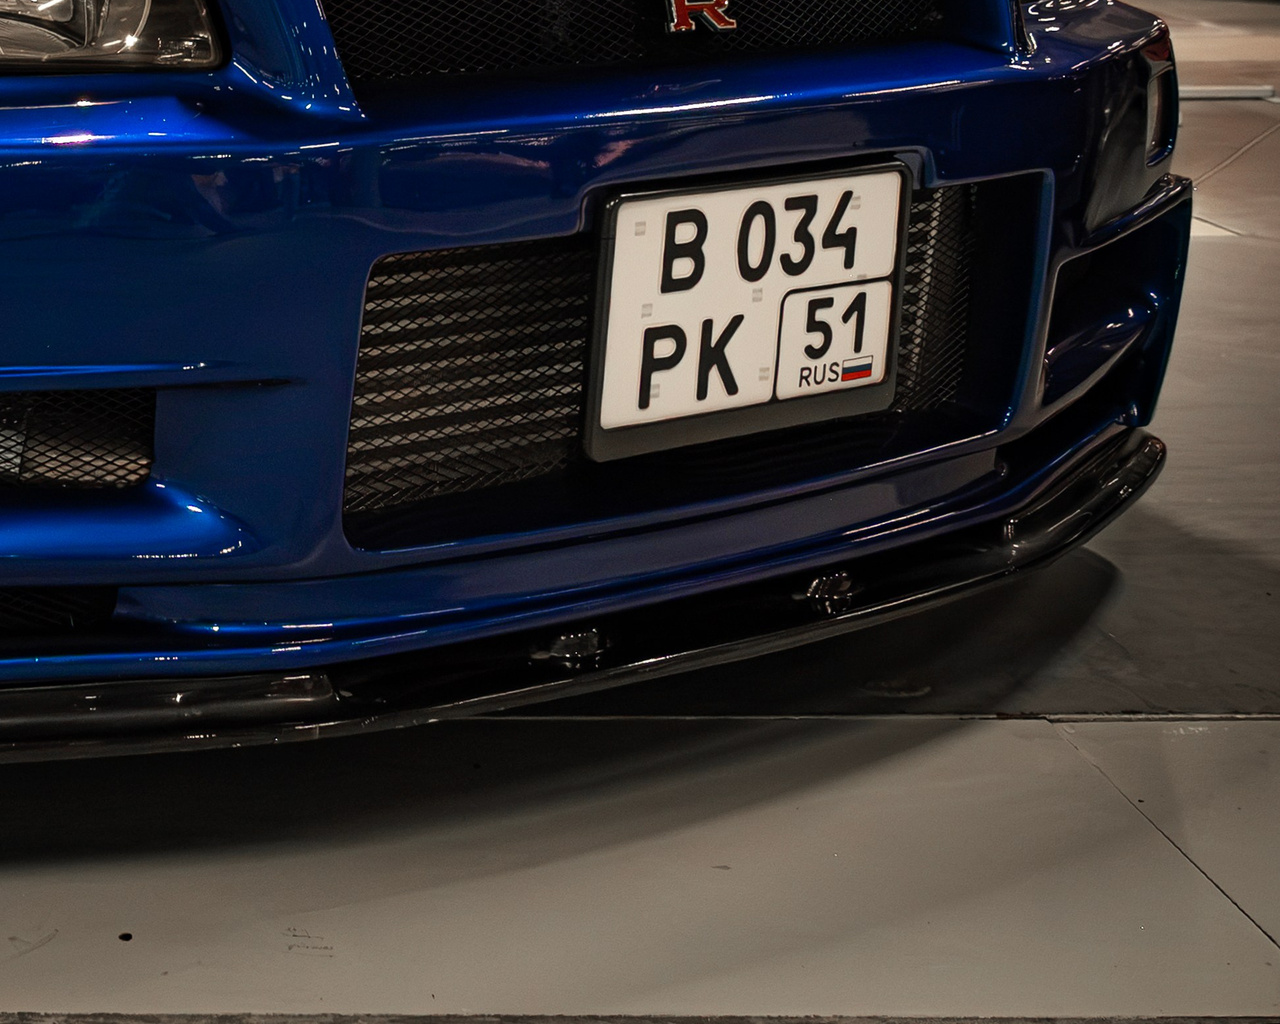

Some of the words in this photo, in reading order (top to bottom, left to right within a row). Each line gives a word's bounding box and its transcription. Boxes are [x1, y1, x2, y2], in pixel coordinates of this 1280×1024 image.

[659, 208, 708, 294] B
[736, 190, 858, 283] 034
[637, 313, 746, 410] PK
[803, 291, 867, 359] 51
[799, 361, 840, 387] RUS
